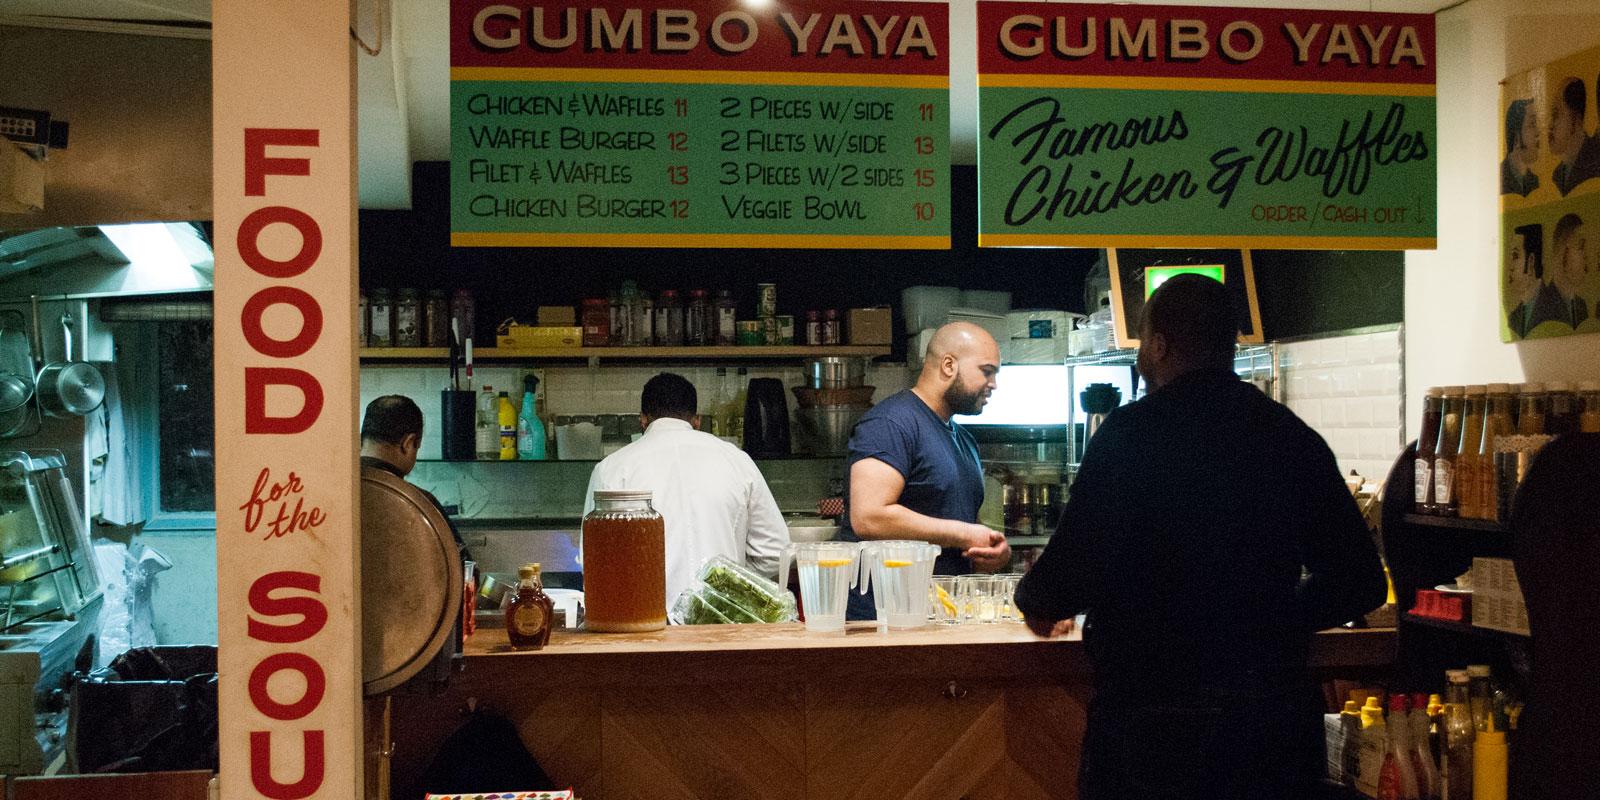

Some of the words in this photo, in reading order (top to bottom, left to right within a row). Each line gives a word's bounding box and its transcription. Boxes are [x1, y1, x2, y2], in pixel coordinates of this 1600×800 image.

[472, 4, 760, 56] GUMBO
[777, 12, 939, 58] YAYA
[999, 14, 1265, 63] GUMBO
[1283, 21, 1426, 67] YAYA
[467, 93, 563, 116] CHICKEN
[568, 93, 581, 118] &
[582, 93, 665, 117] WAFFLES
[674, 97, 688, 117] 11
[719, 97, 741, 118] 2
[750, 96, 812, 120] PIECES
[918, 103, 934, 122] 11
[468, 126, 551, 149] WAFFLE
[560, 127, 656, 150] BURGER
[667, 132, 689, 152] 12
[720, 129, 740, 151] 2
[746, 129, 806, 152] FILETS
[914, 136, 935, 155] 13
[987, 96, 1189, 167] Famous
[469, 158, 524, 183] FILET
[529, 161, 542, 185] &
[547, 160, 632, 184] WAFFLES
[667, 165, 689, 185] 13
[719, 161, 740, 185] 3
[745, 162, 801, 185] PIECES
[863, 168, 904, 188] SIDES
[913, 168, 935, 188] 15
[1004, 157, 1198, 226] Chicken
[1206, 147, 1255, 210] &
[1255, 101, 1428, 199] Waffles
[469, 195, 567, 218] CHICKEN
[576, 194, 666, 218] BURGER
[669, 199, 689, 219] 12
[721, 195, 792, 219] VEGGIE
[912, 202, 935, 221] 10
[1374, 207, 1407, 224] OUT
[236, 128, 325, 435] FOOD
[239, 467, 304, 533] for
[264, 497, 326, 541] the
